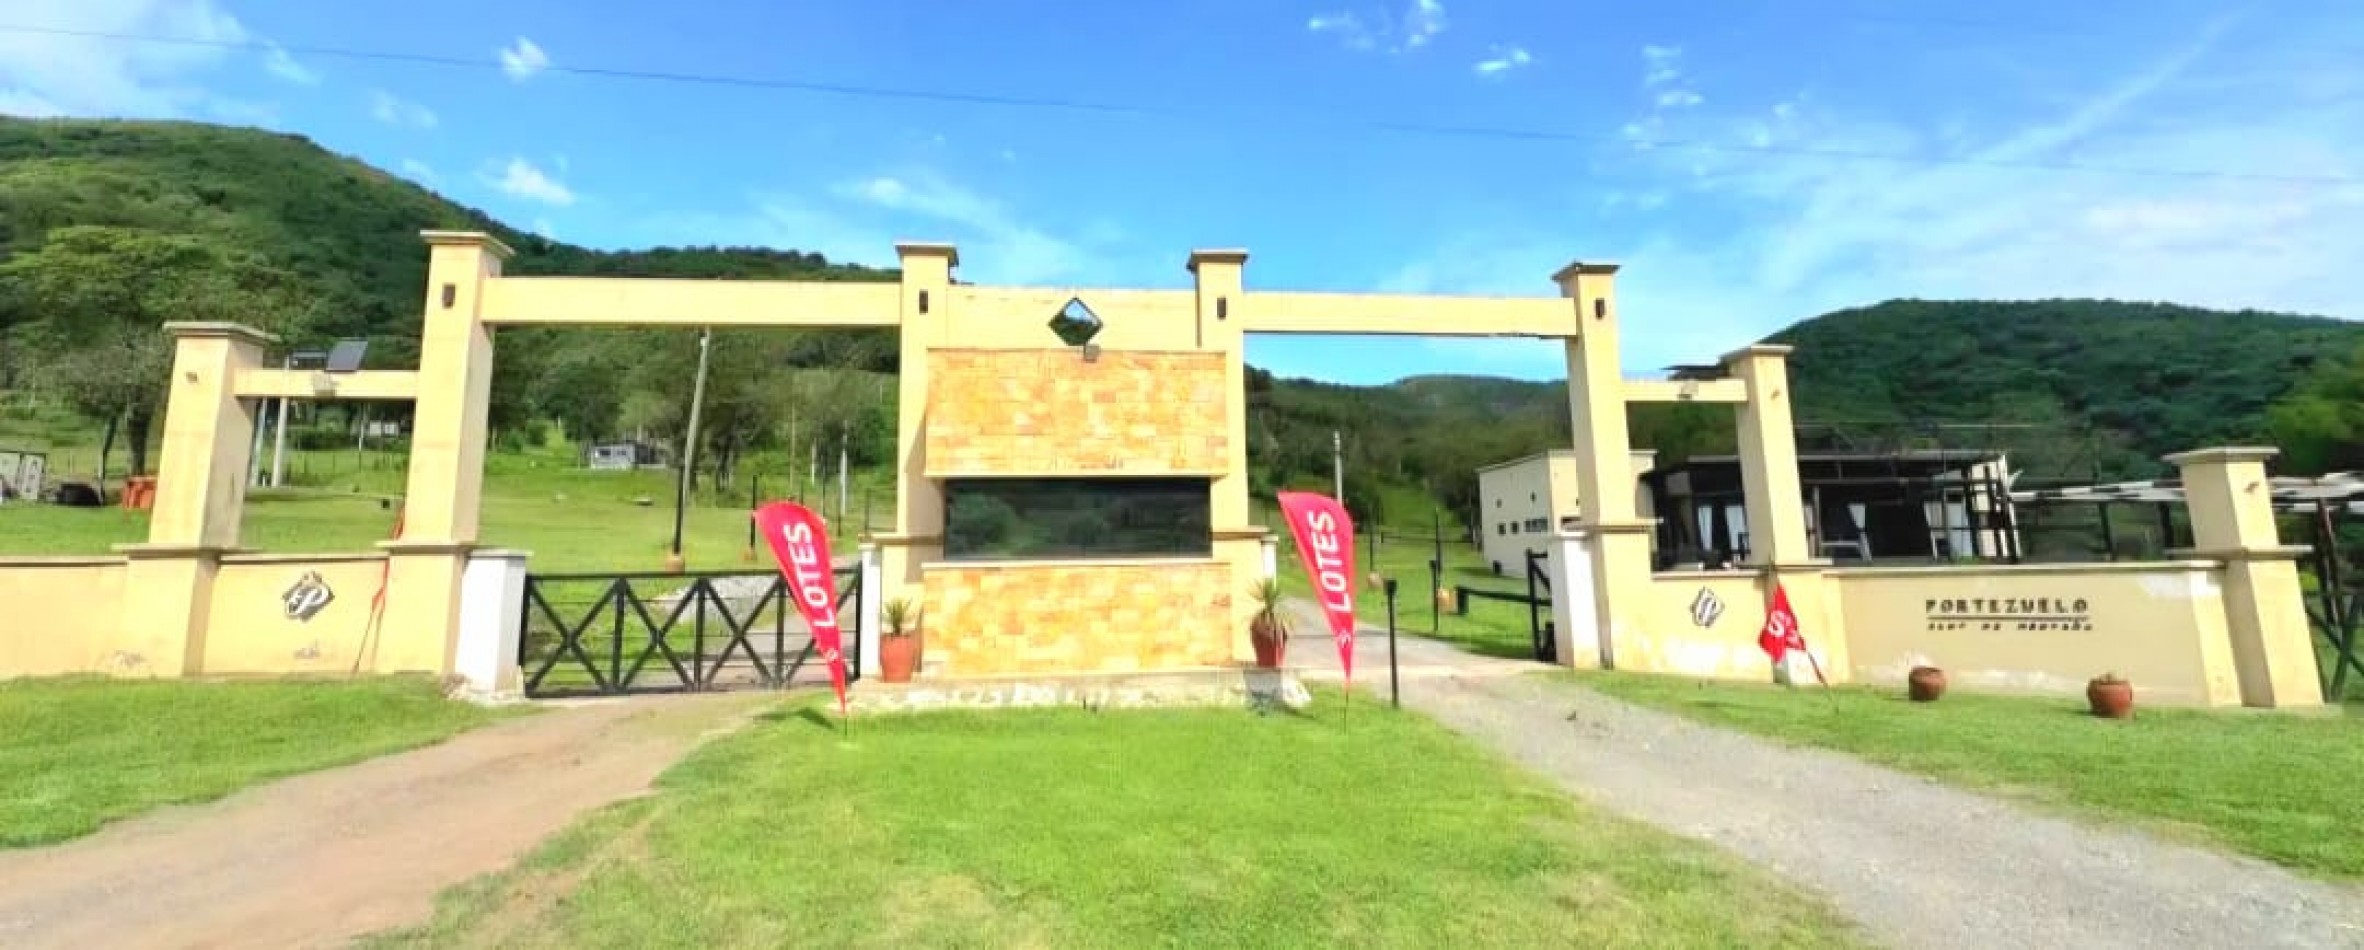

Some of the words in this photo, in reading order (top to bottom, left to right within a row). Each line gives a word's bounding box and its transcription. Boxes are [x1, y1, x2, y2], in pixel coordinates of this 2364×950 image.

[783, 522, 835, 627] LOTES
[1307, 510, 1351, 612] LOTES
[1926, 598, 2089, 614] PORTEZUELO
